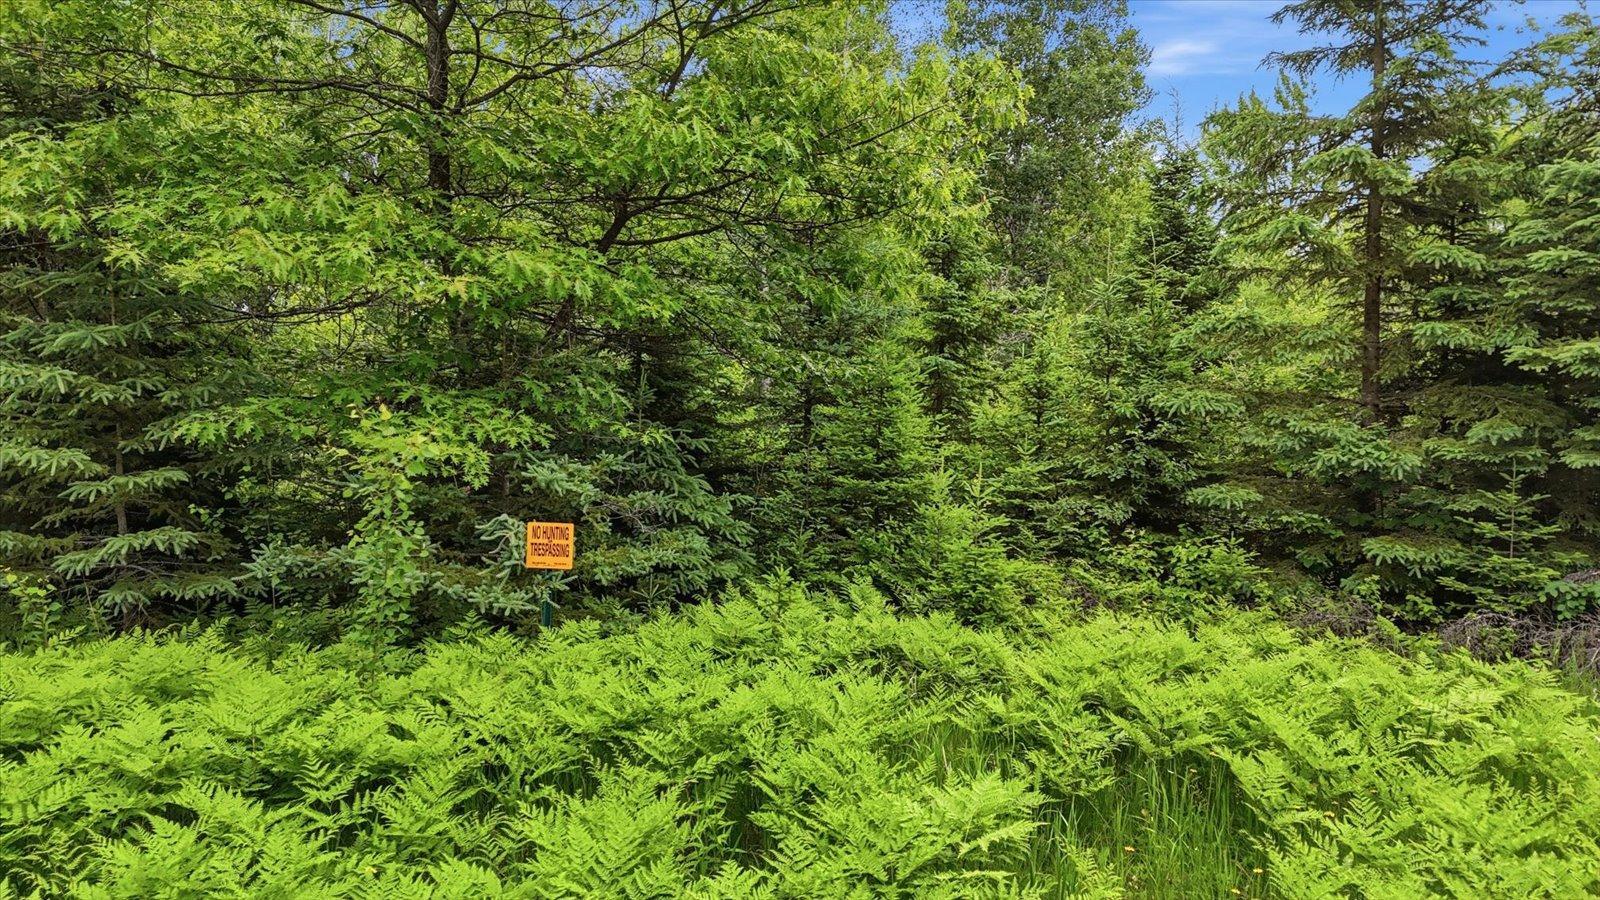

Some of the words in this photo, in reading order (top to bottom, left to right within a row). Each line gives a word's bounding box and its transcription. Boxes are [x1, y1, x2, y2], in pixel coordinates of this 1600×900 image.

[532, 525, 541, 539] NO
[542, 526, 569, 540] HUNTING
[530, 543, 570, 557] TRESPASSING
